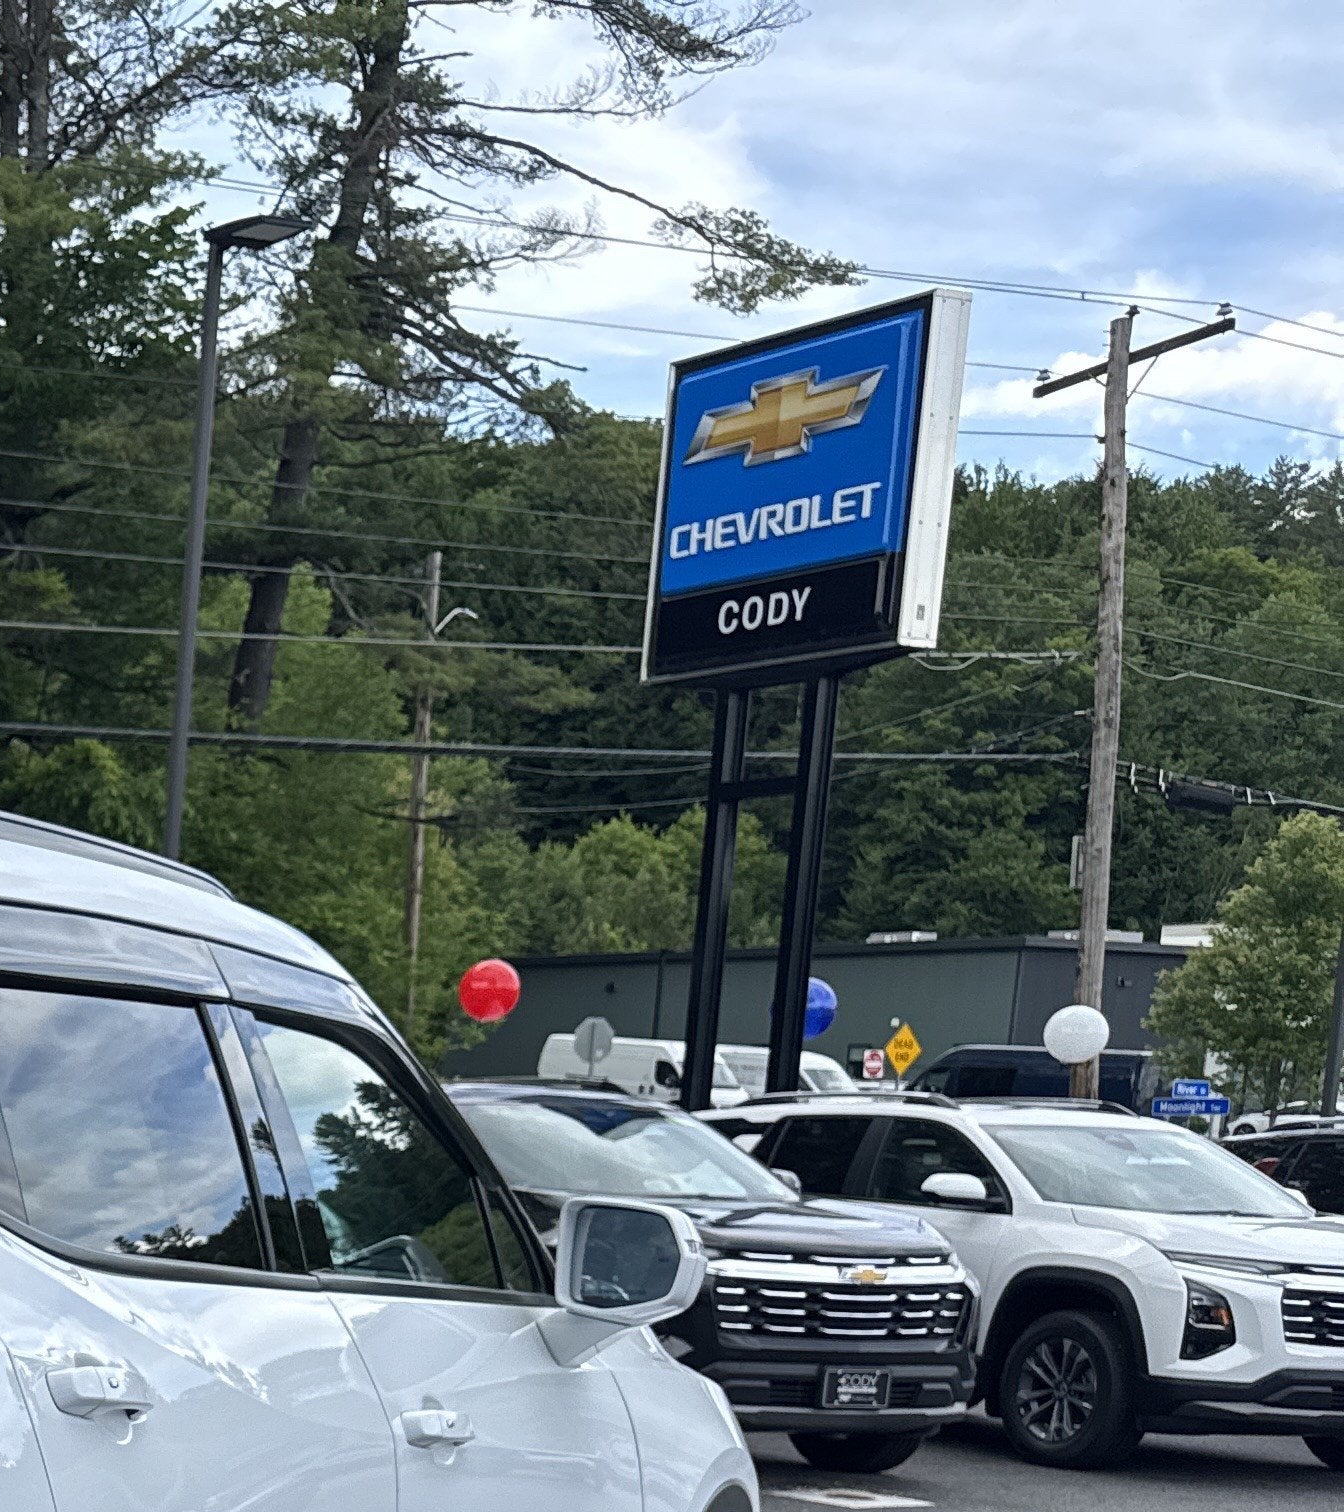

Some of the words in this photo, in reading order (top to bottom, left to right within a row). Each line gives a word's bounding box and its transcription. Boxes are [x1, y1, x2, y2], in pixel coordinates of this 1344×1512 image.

[669, 482, 882, 560] CHEVROLET
[717, 587, 811, 636] CODY
[1160, 1102, 1205, 1115] Moonlight
